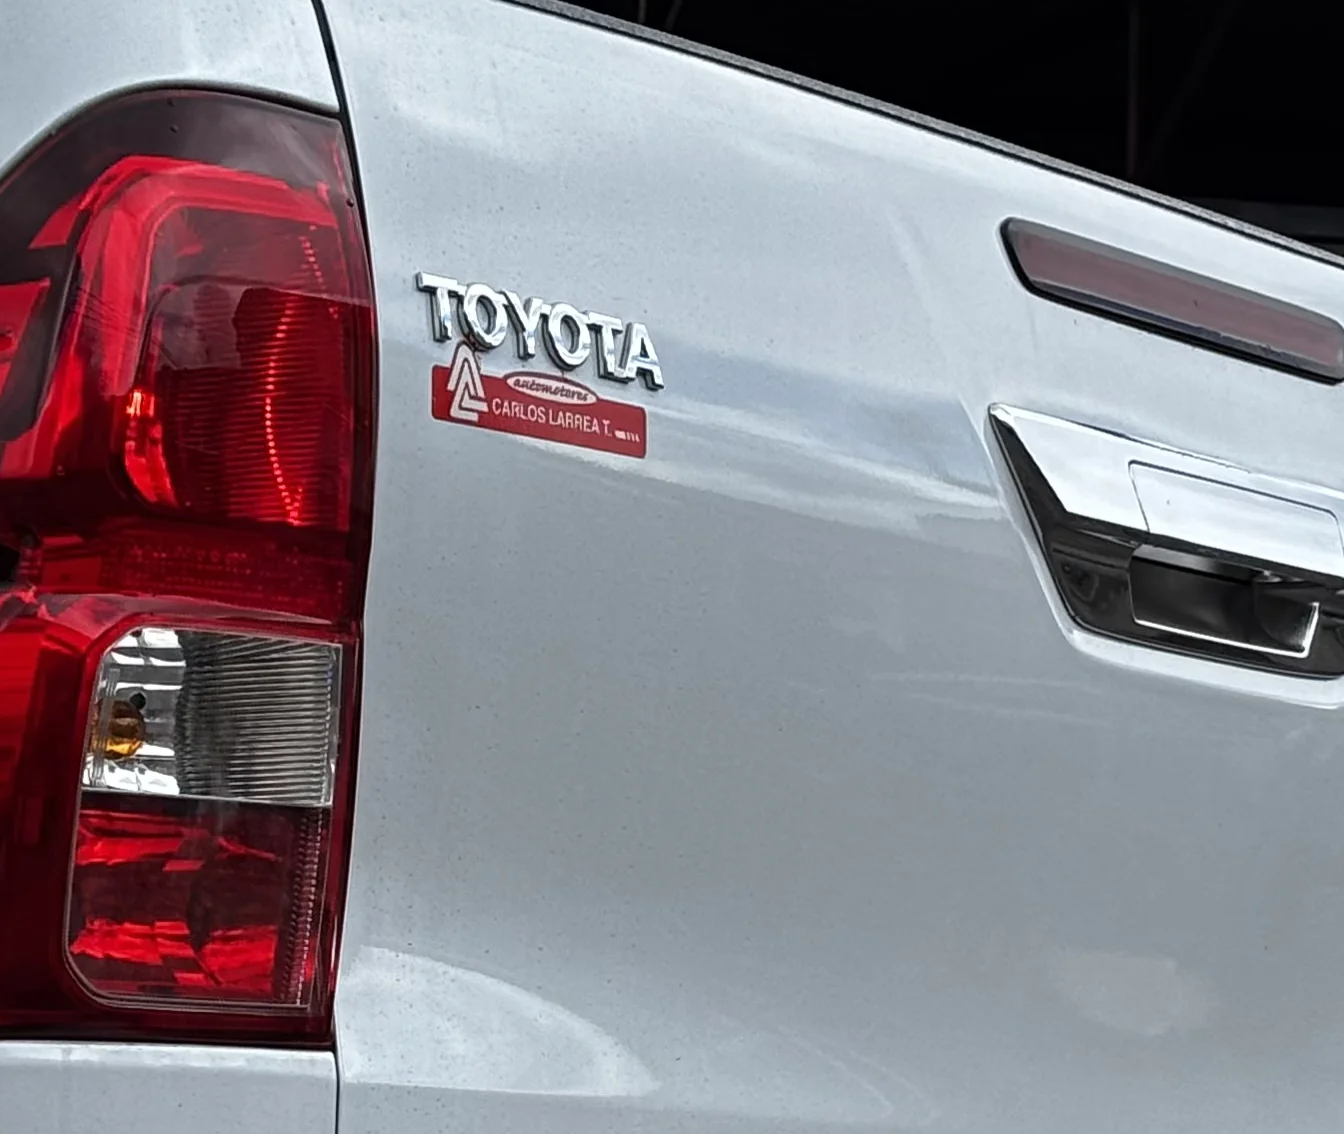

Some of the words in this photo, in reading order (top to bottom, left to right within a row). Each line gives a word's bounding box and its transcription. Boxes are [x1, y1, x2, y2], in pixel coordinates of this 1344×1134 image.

[415, 270, 665, 392] TOYOTA
[492, 397, 547, 424] CARLOS
[548, 408, 601, 435] LARREA
